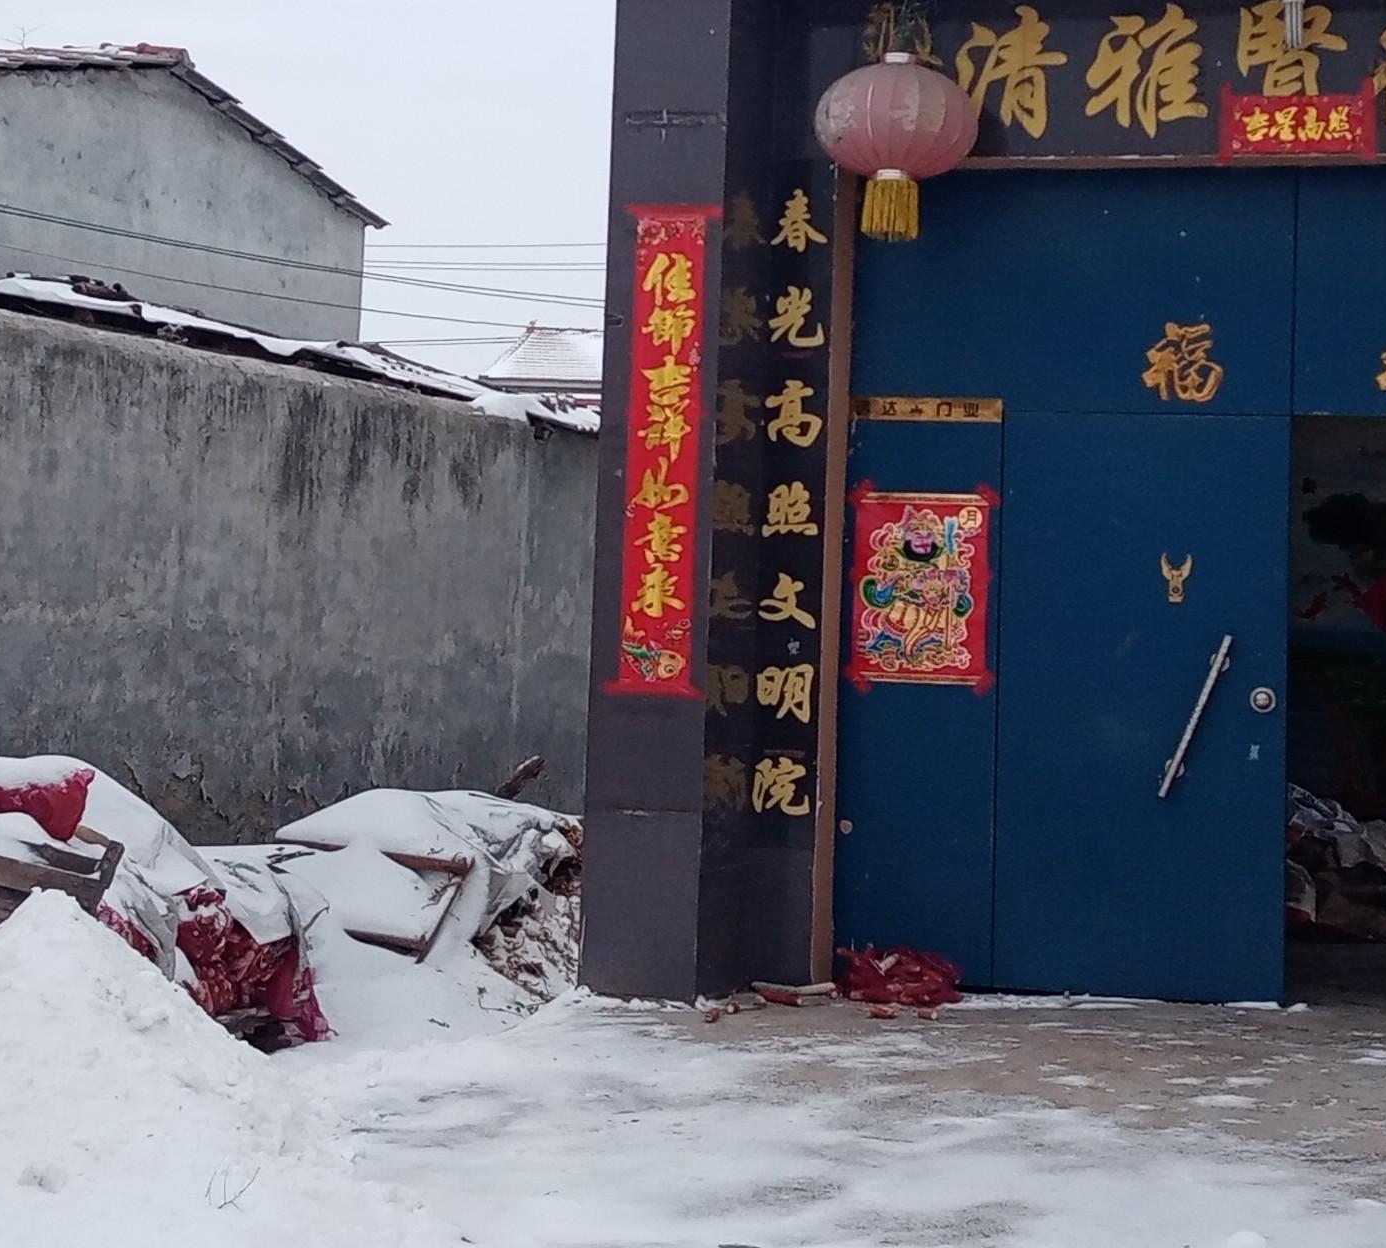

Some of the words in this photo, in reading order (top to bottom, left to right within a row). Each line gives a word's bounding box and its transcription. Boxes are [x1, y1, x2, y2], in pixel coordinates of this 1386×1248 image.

[1242, 105, 1353, 142] 吉星高照
[1143, 320, 1224, 403] 福
[751, 188, 829, 817] 春光高照文明院
[963, 509, 978, 525] 月
